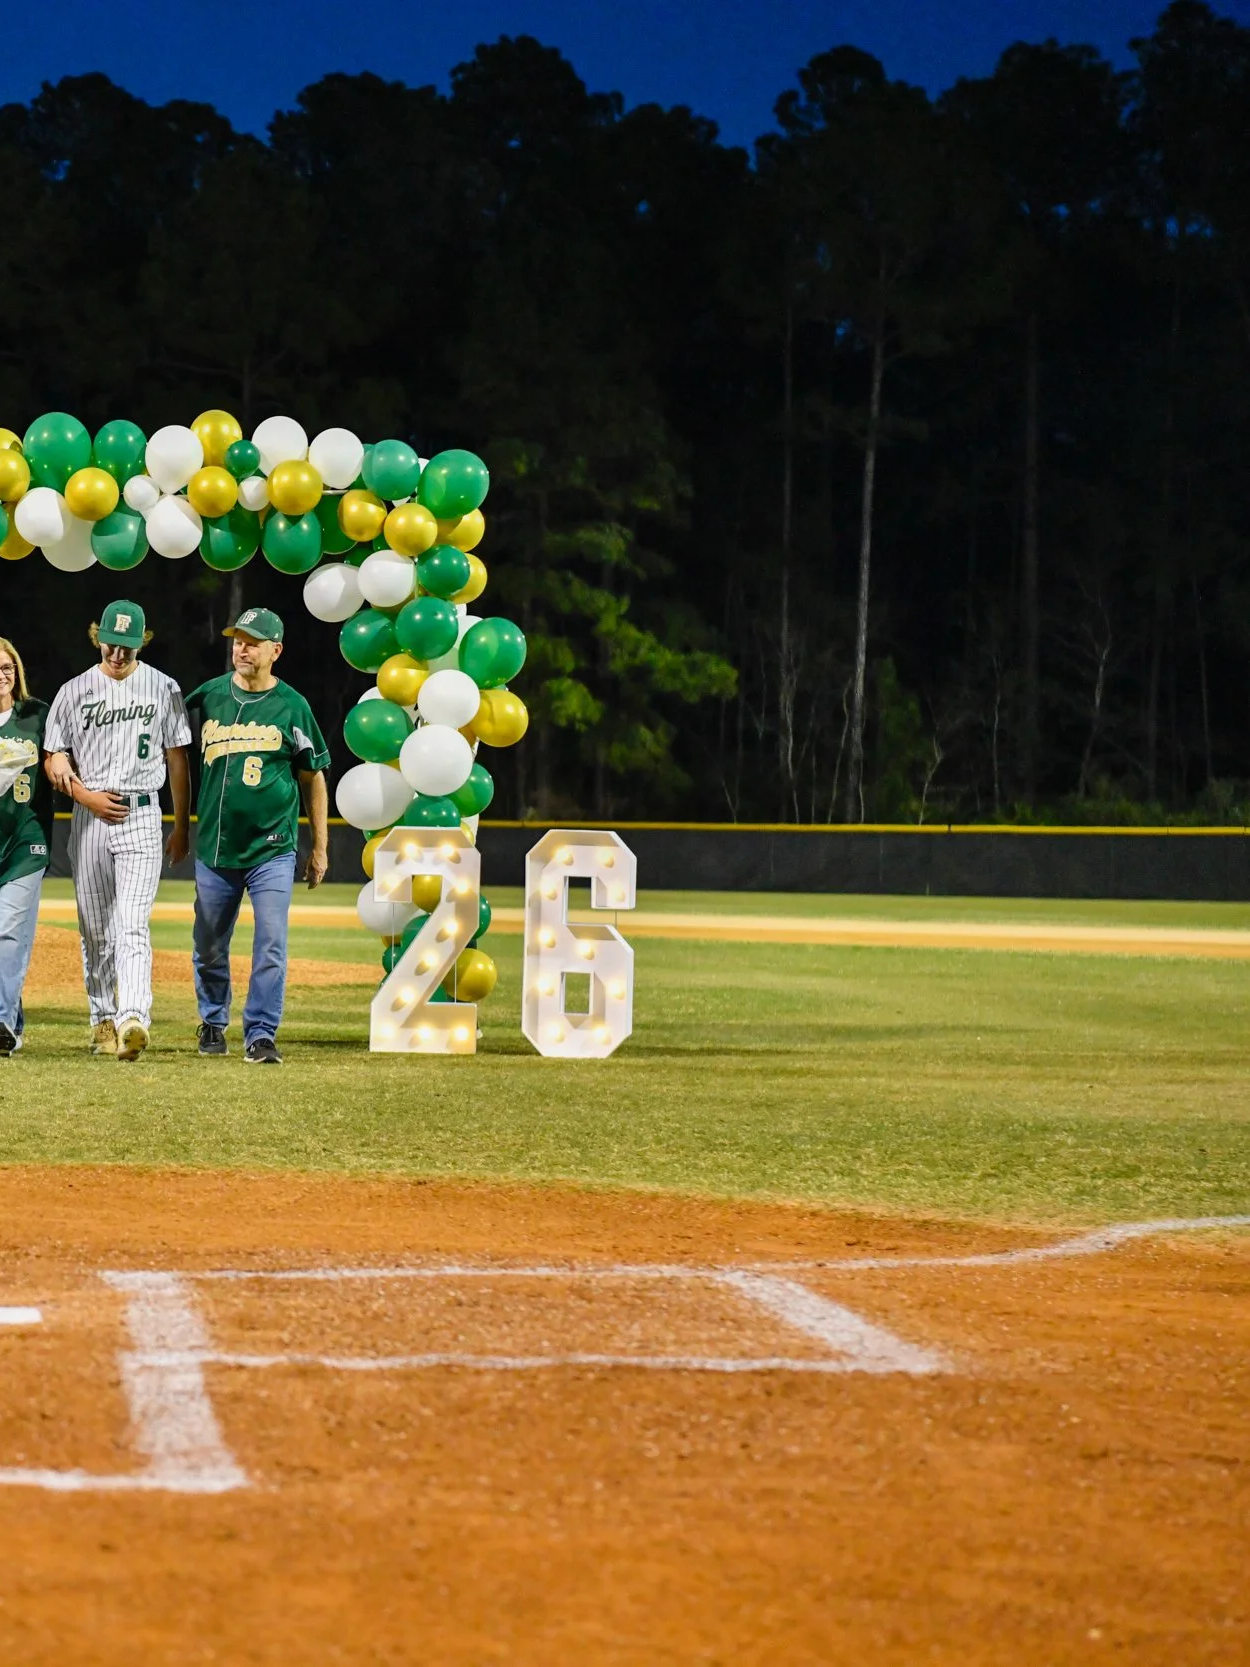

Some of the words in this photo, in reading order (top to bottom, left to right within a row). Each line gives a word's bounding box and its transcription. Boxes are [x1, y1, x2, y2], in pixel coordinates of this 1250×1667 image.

[81, 700, 158, 730] Fleming
[137, 733, 151, 759] 6
[242, 756, 263, 786] 6
[13, 773, 31, 803] 6
